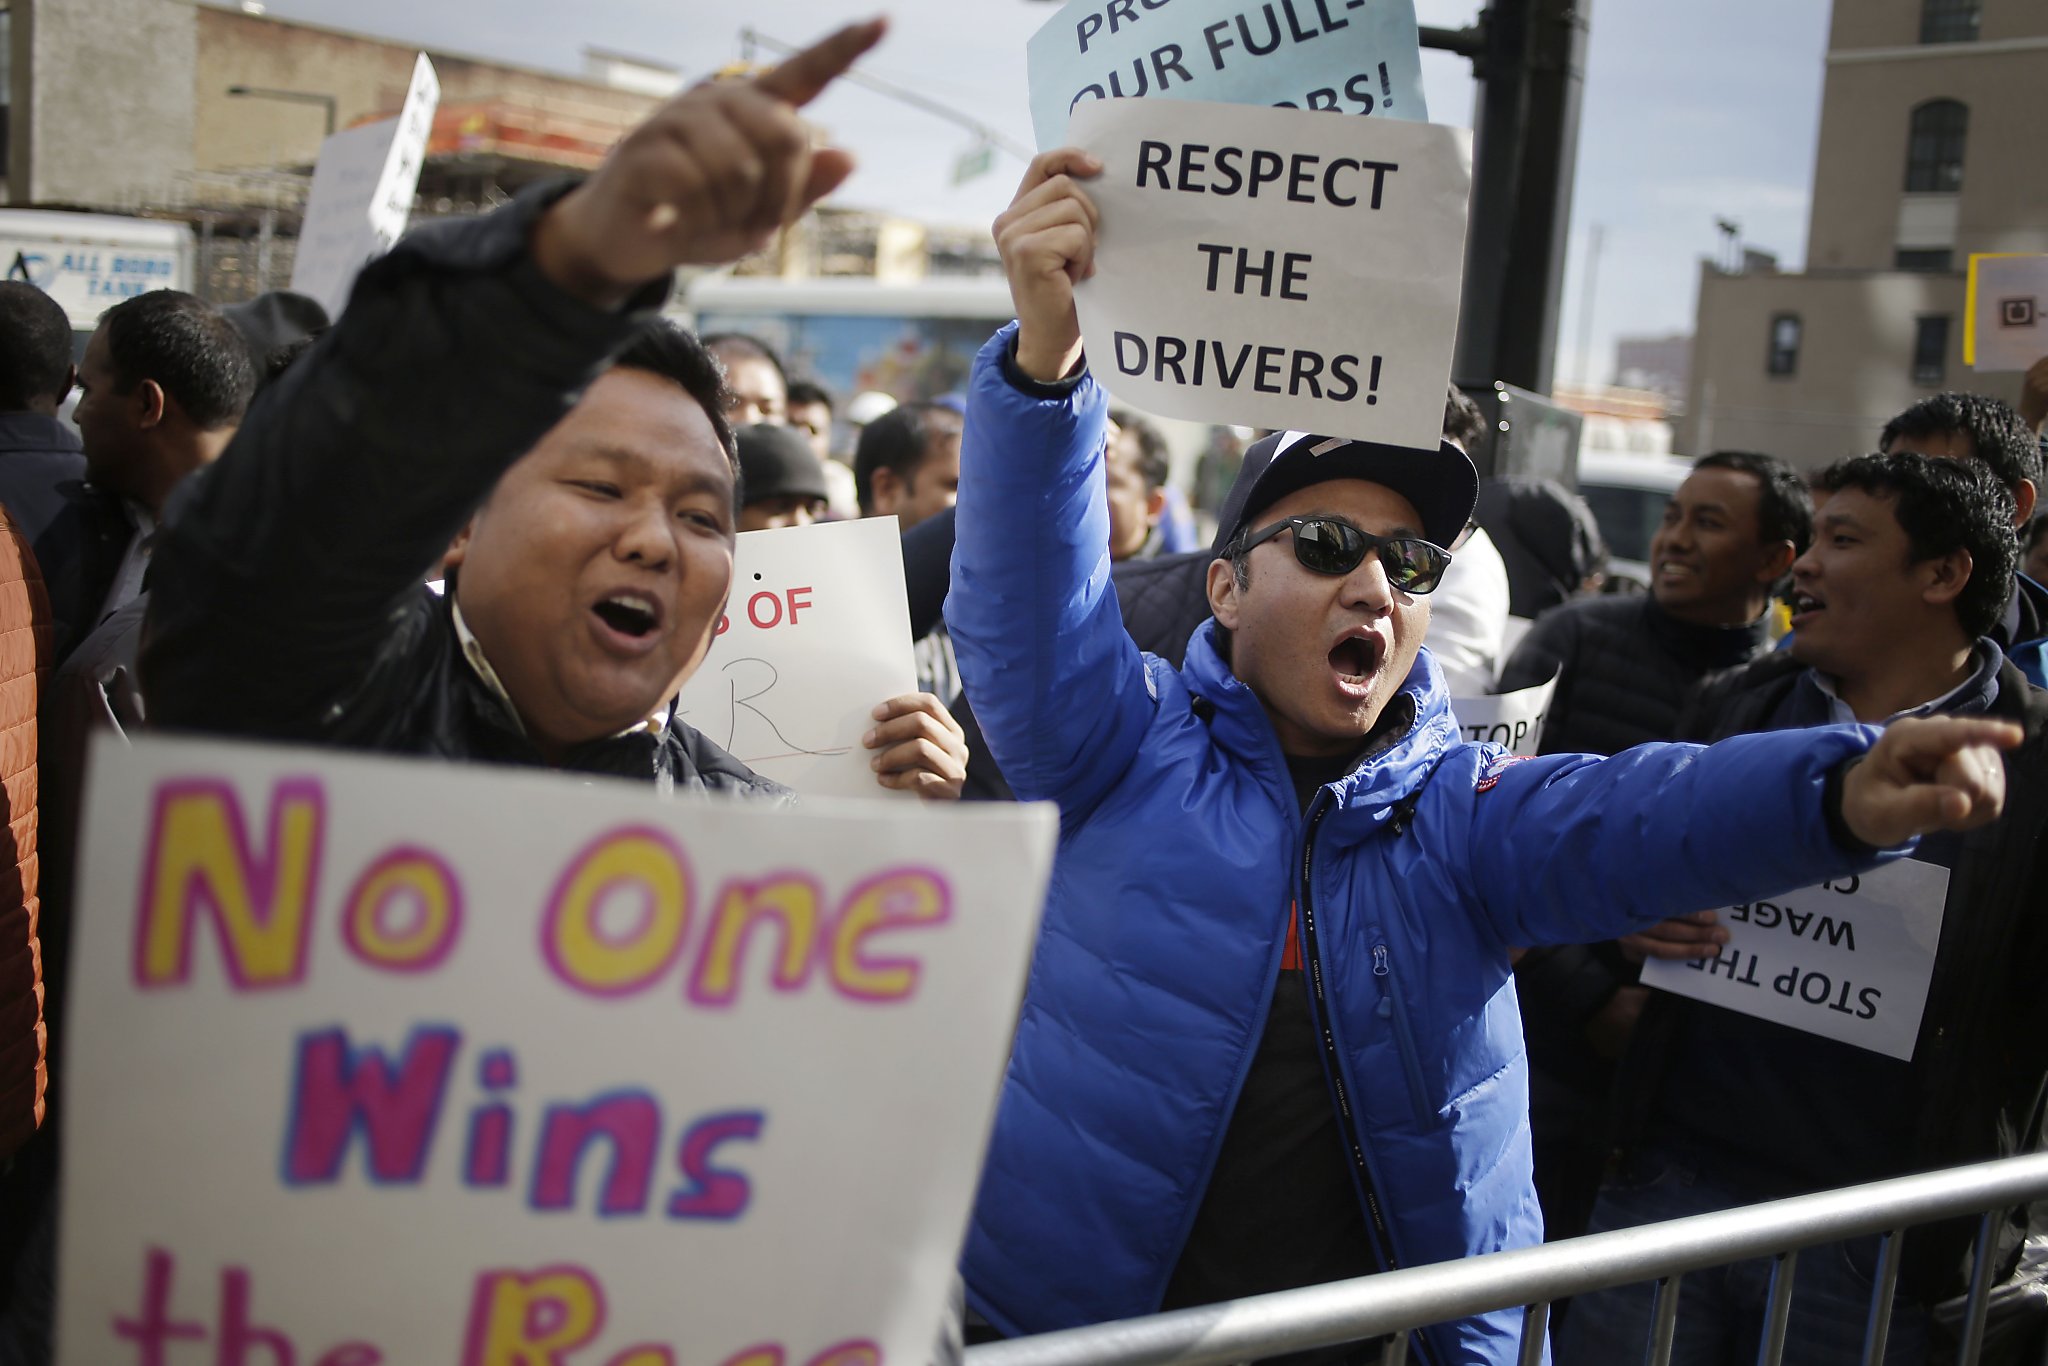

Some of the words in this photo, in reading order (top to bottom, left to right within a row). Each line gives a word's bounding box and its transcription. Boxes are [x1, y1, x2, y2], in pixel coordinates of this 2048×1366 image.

[1203, 0, 1365, 71] FULL-
[1136, 140, 1399, 210] RESPECT
[61, 254, 99, 272] ALL
[1197, 243, 1312, 301] THE
[1113, 330, 1383, 406] DRIVERS!
[747, 586, 812, 629] OF
[1460, 720, 1527, 751] TOP
[133, 775, 464, 992] No
[539, 825, 953, 1007] One
[1772, 966, 1882, 1020] STOP
[280, 1023, 767, 1222] Wins
